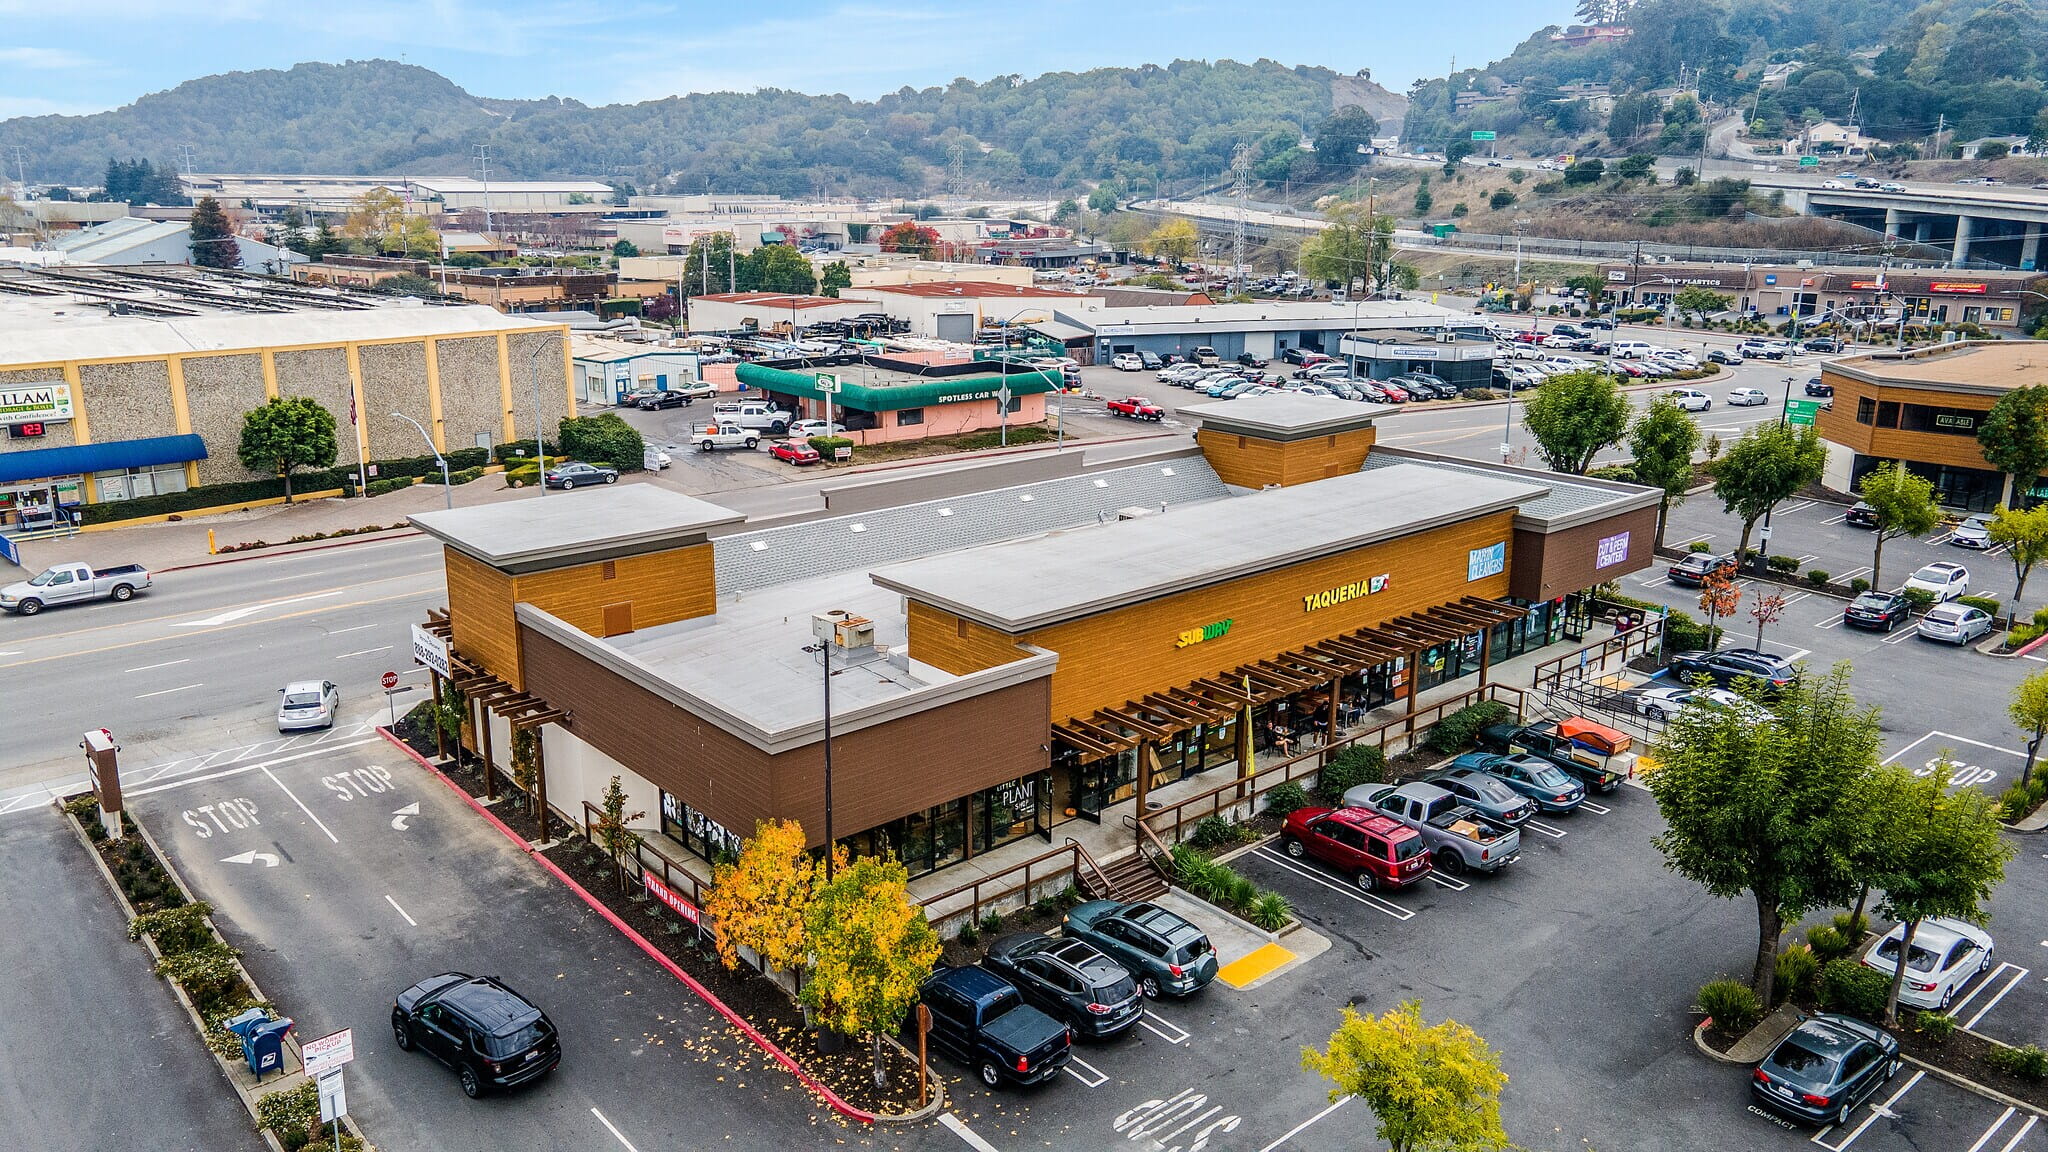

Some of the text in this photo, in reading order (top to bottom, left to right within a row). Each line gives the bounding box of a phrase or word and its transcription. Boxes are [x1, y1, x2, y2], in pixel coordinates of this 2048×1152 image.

[0, 391, 51, 406] LLAM
[938, 393, 973, 403] SPOTLESS
[974, 391, 990, 399] CAR
[23, 424, 42, 436] 123
[1940, 417, 1970, 426] AVAABLE
[1600, 549, 1624, 567] CENTER
[1304, 580, 1369, 612] TAQUERIA
[1175, 618, 1233, 648] SUBWAY
[382, 675, 398, 685] STOP
[321, 765, 395, 801] STOP
[996, 780, 1016, 792] LITTLE
[1003, 780, 1034, 806] PLANT
[1014, 799, 1029, 811] SHOP
[182, 797, 261, 838] STOP
[646, 875, 697, 921] GRAND OPENING
[306, 1032, 347, 1051] NO WORKER
[314, 1039, 342, 1053] PICKUP
[1113, 1087, 1241, 1152] STOP
[1747, 1105, 1797, 1130] COMPACT
